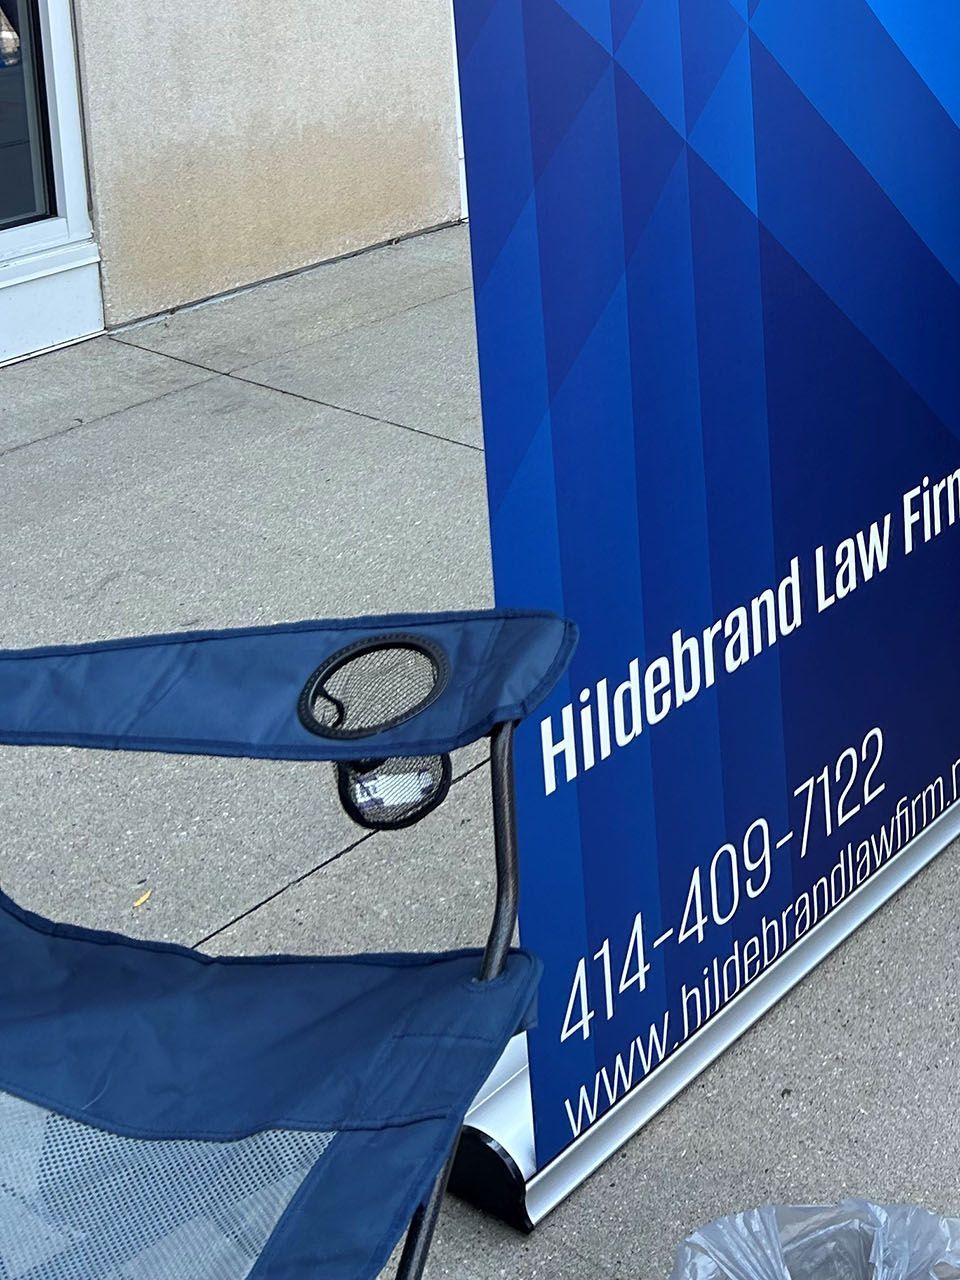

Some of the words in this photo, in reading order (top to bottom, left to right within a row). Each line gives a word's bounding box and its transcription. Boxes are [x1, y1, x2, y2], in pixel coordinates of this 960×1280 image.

[540, 556, 802, 796] Hildebrand
[815, 513, 891, 613] Law
[560, 726, 886, 1043] 414-409-7122
